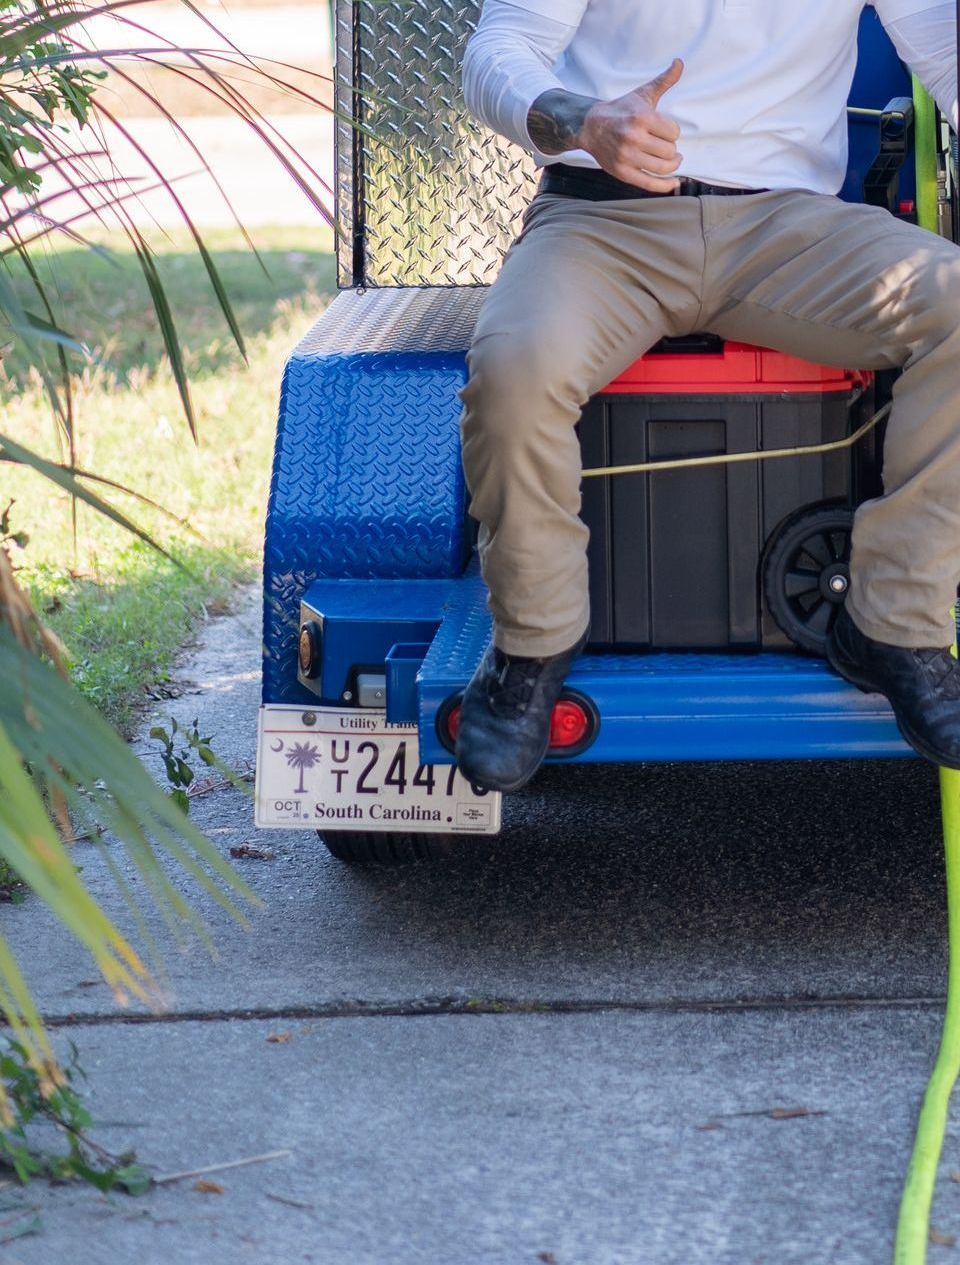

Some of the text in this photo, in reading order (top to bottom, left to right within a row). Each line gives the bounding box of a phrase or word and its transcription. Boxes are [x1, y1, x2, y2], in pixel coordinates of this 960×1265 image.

[339, 717, 378, 730] Utility
[356, 741, 489, 796] 244
[274, 801, 300, 811] OCT
[314, 803, 441, 821] South Carolina
